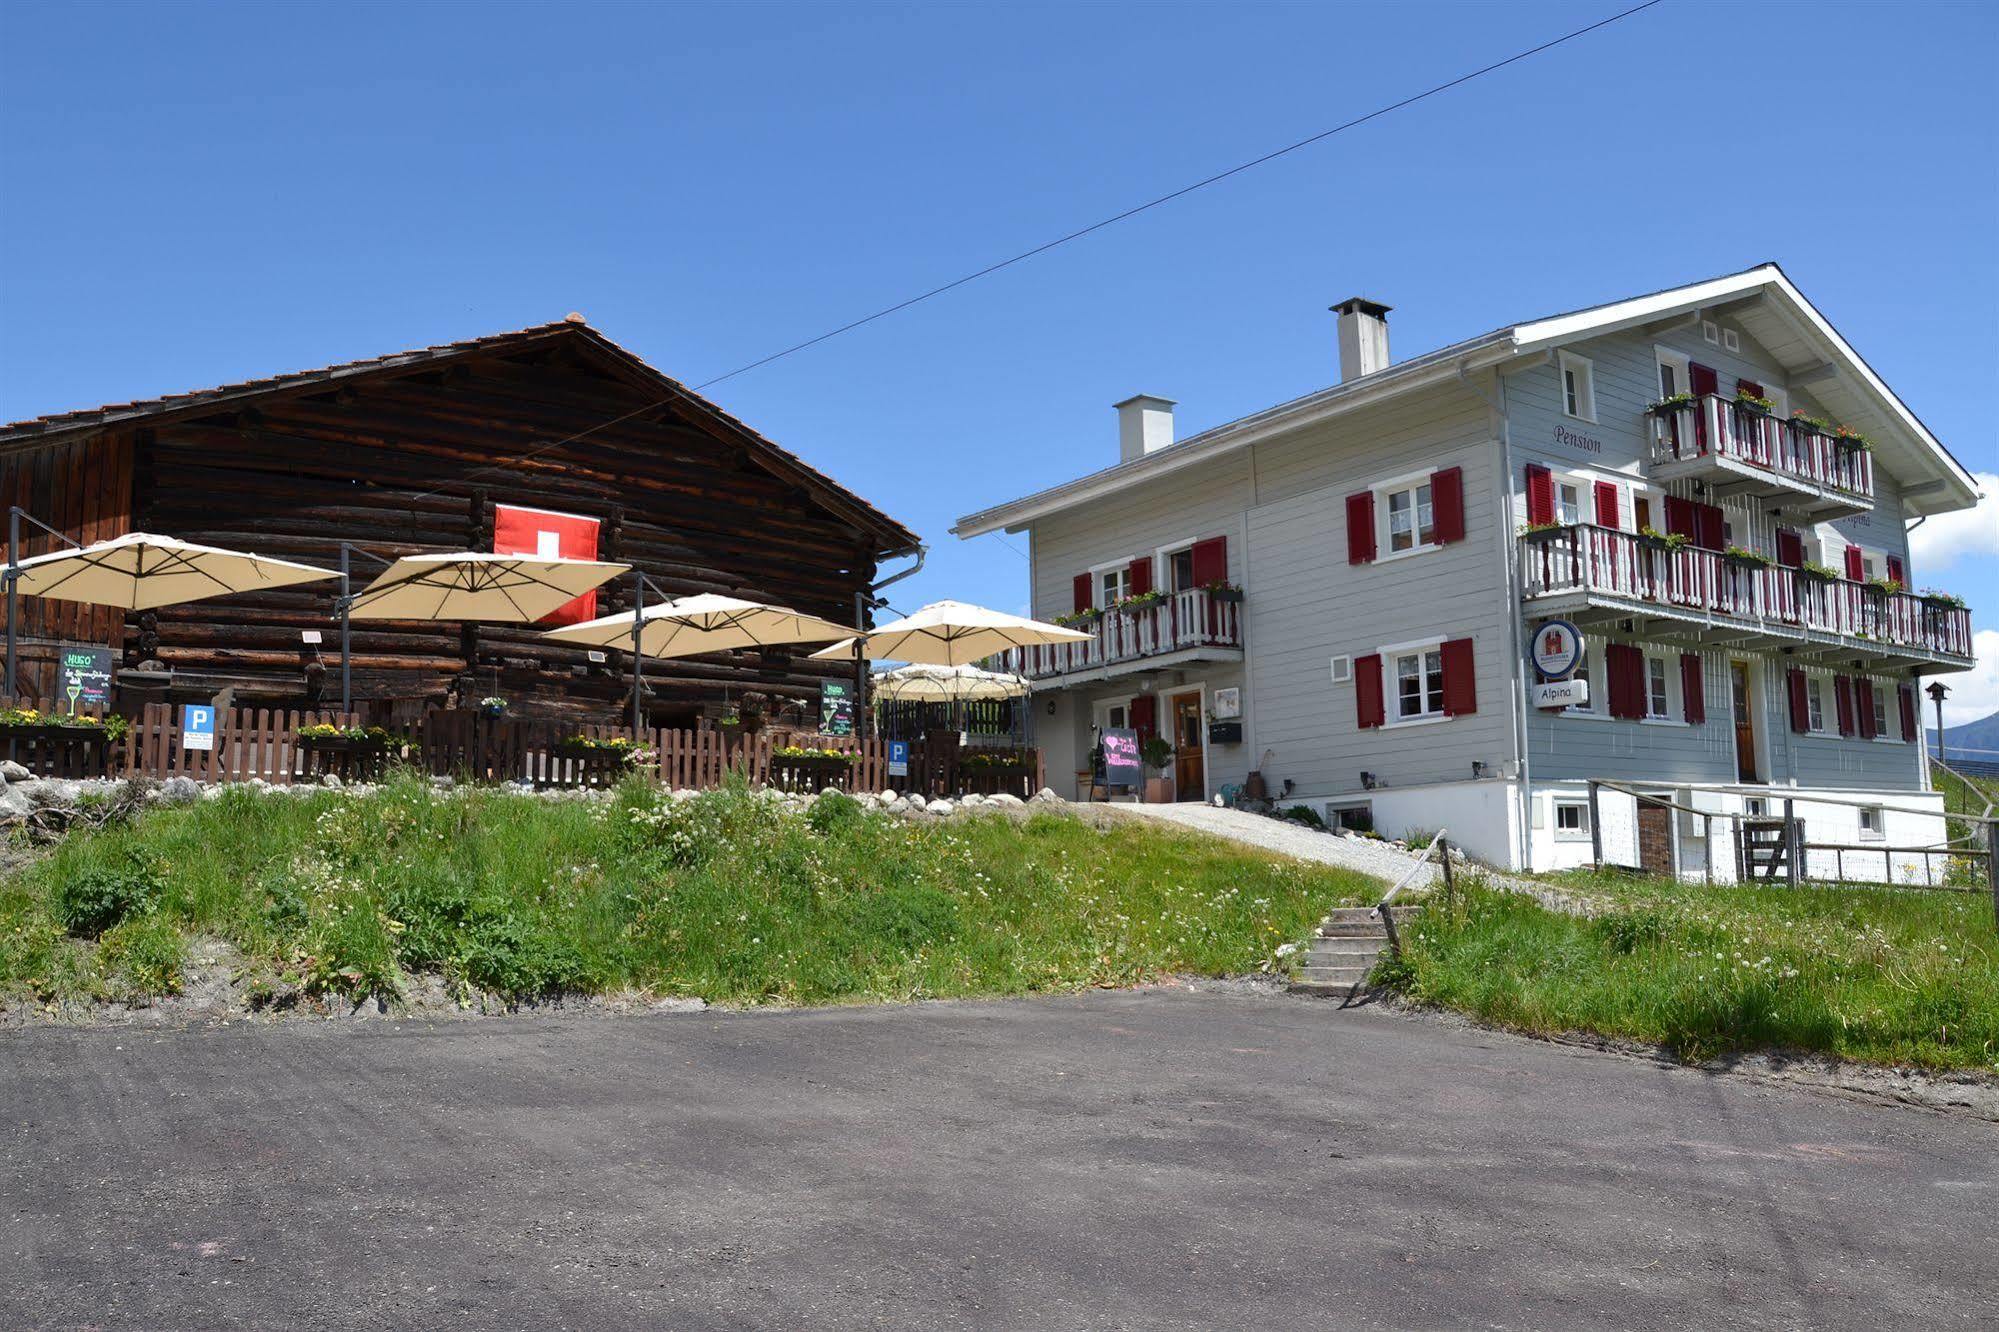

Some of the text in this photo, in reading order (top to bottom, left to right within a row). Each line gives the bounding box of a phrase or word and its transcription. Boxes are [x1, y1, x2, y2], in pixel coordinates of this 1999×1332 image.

[1553, 425, 1601, 454] Pension
[1541, 687, 1572, 701] Alpina
[192, 709, 208, 730] P
[893, 744, 903, 761] P
